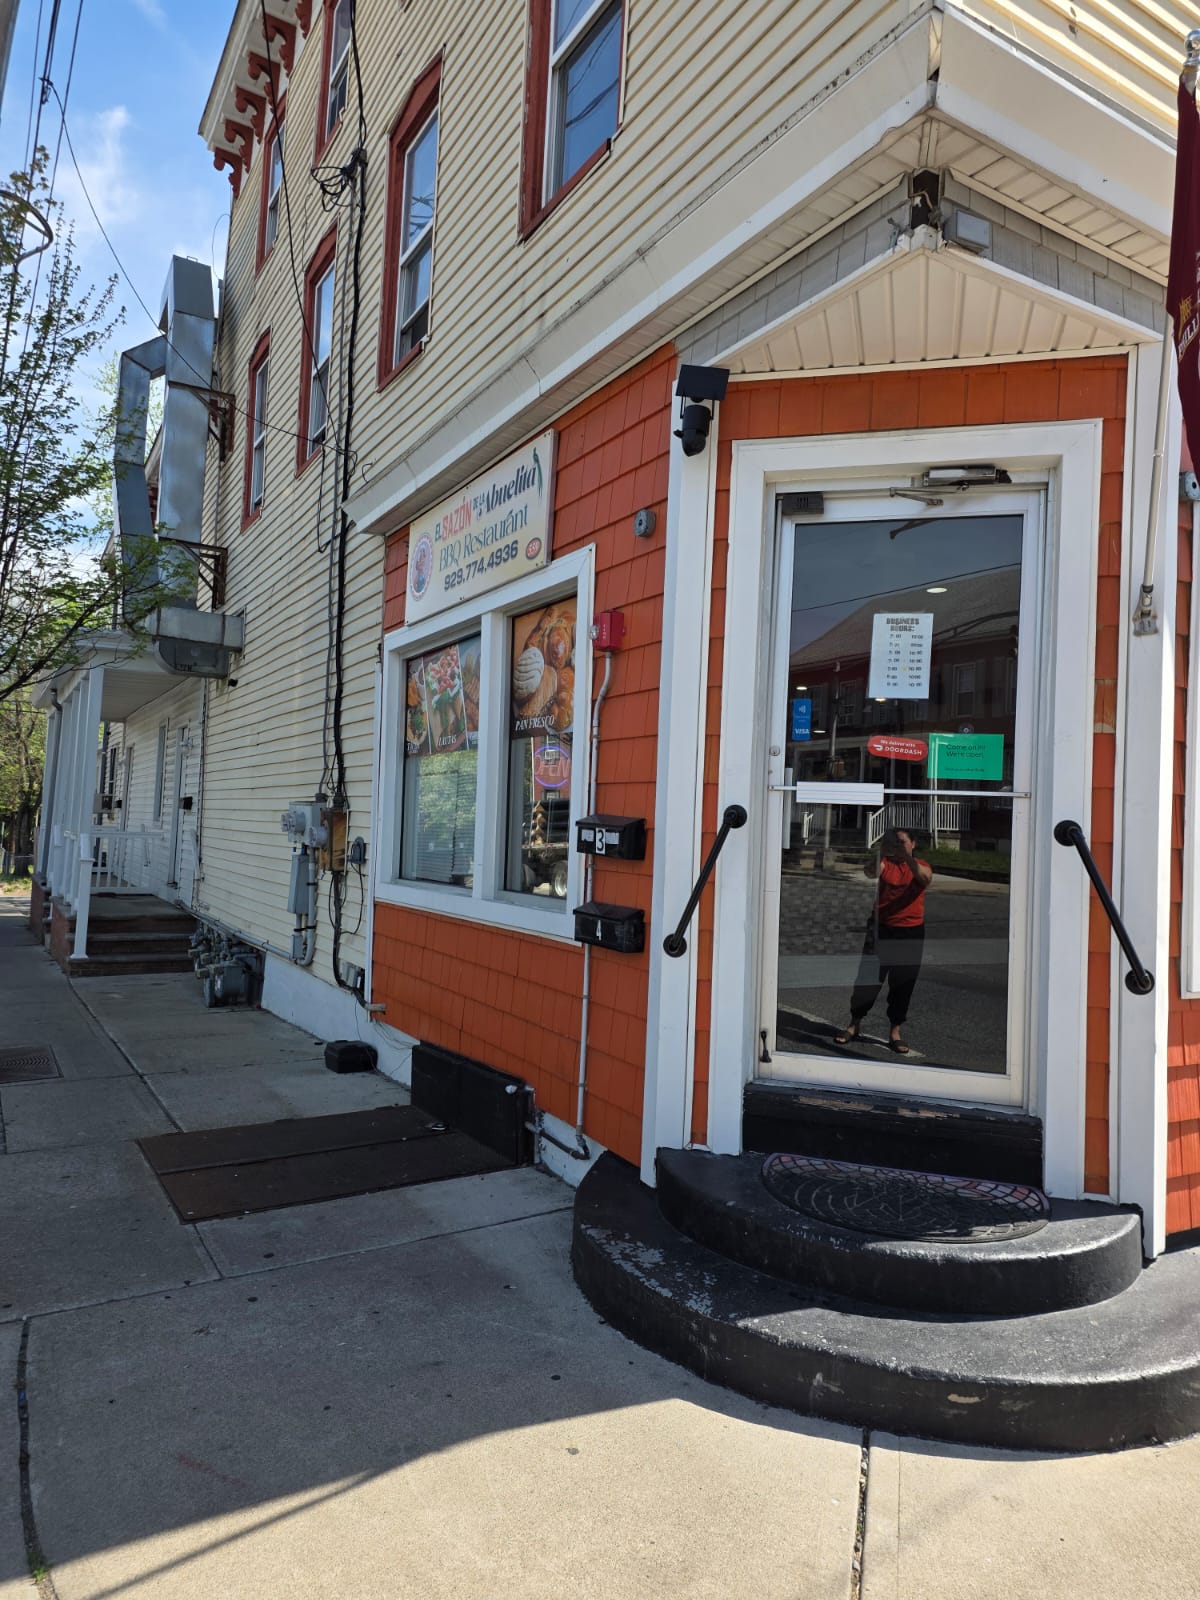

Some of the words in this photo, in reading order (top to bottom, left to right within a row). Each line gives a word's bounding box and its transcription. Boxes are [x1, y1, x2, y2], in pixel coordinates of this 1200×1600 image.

[435, 522, 441, 541] EL
[442, 496, 472, 542] SAZÓN
[486, 464, 536, 513] Abuelita
[440, 540, 461, 572] BBQ
[444, 540, 518, 591] 929.774.4936
[515, 718, 529, 731] PAN
[529, 715, 555, 729] FRESCO
[884, 746, 922, 756] DOORDASH
[597, 829, 604, 851] 3
